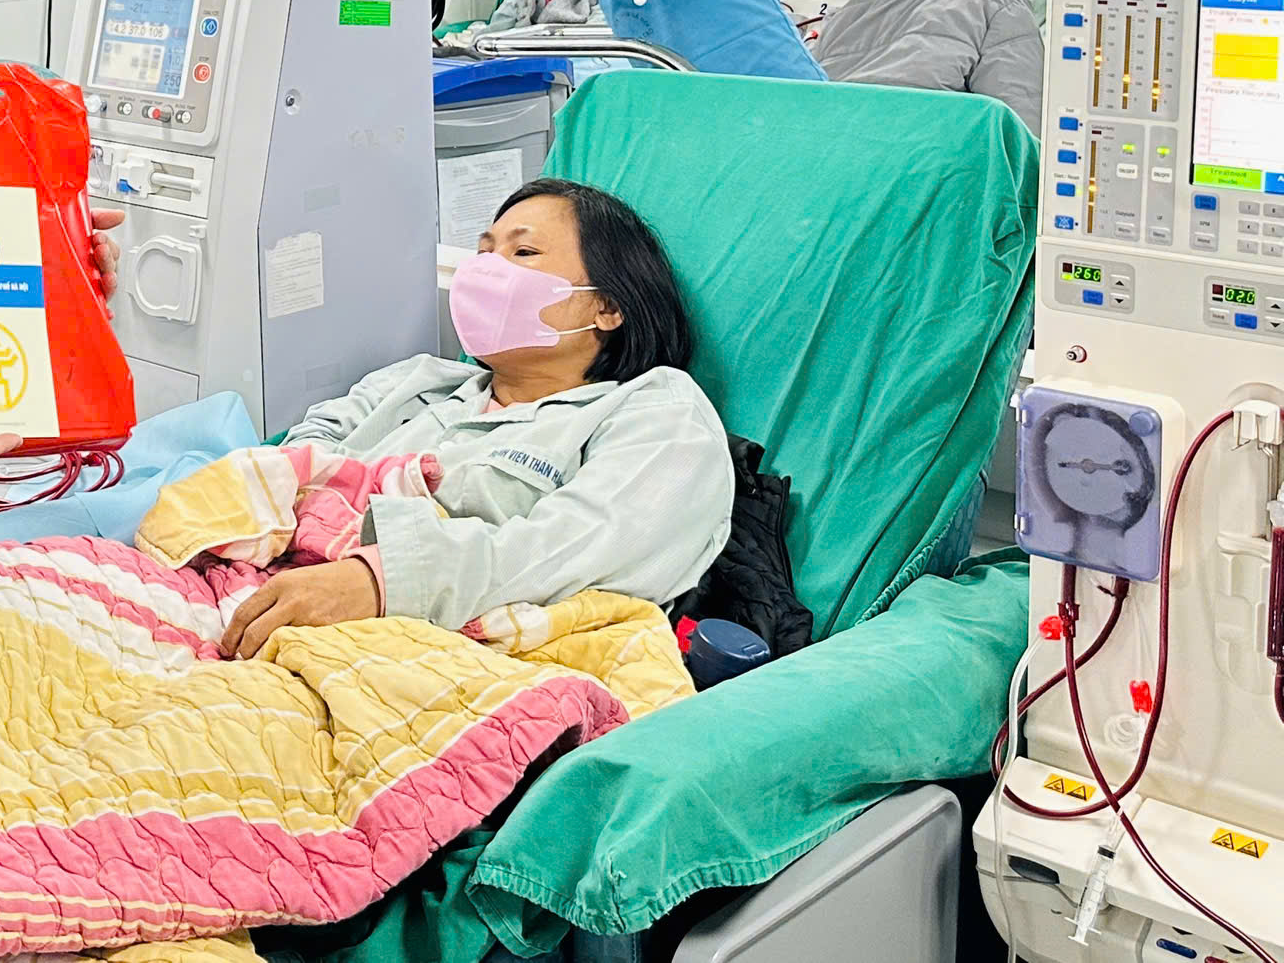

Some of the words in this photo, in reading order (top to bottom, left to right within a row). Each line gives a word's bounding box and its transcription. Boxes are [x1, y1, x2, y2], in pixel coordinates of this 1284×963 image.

[819, 3, 827, 15] 2
[1074, 265, 1101, 282] 260
[1226, 289, 1255, 304] 02.0
